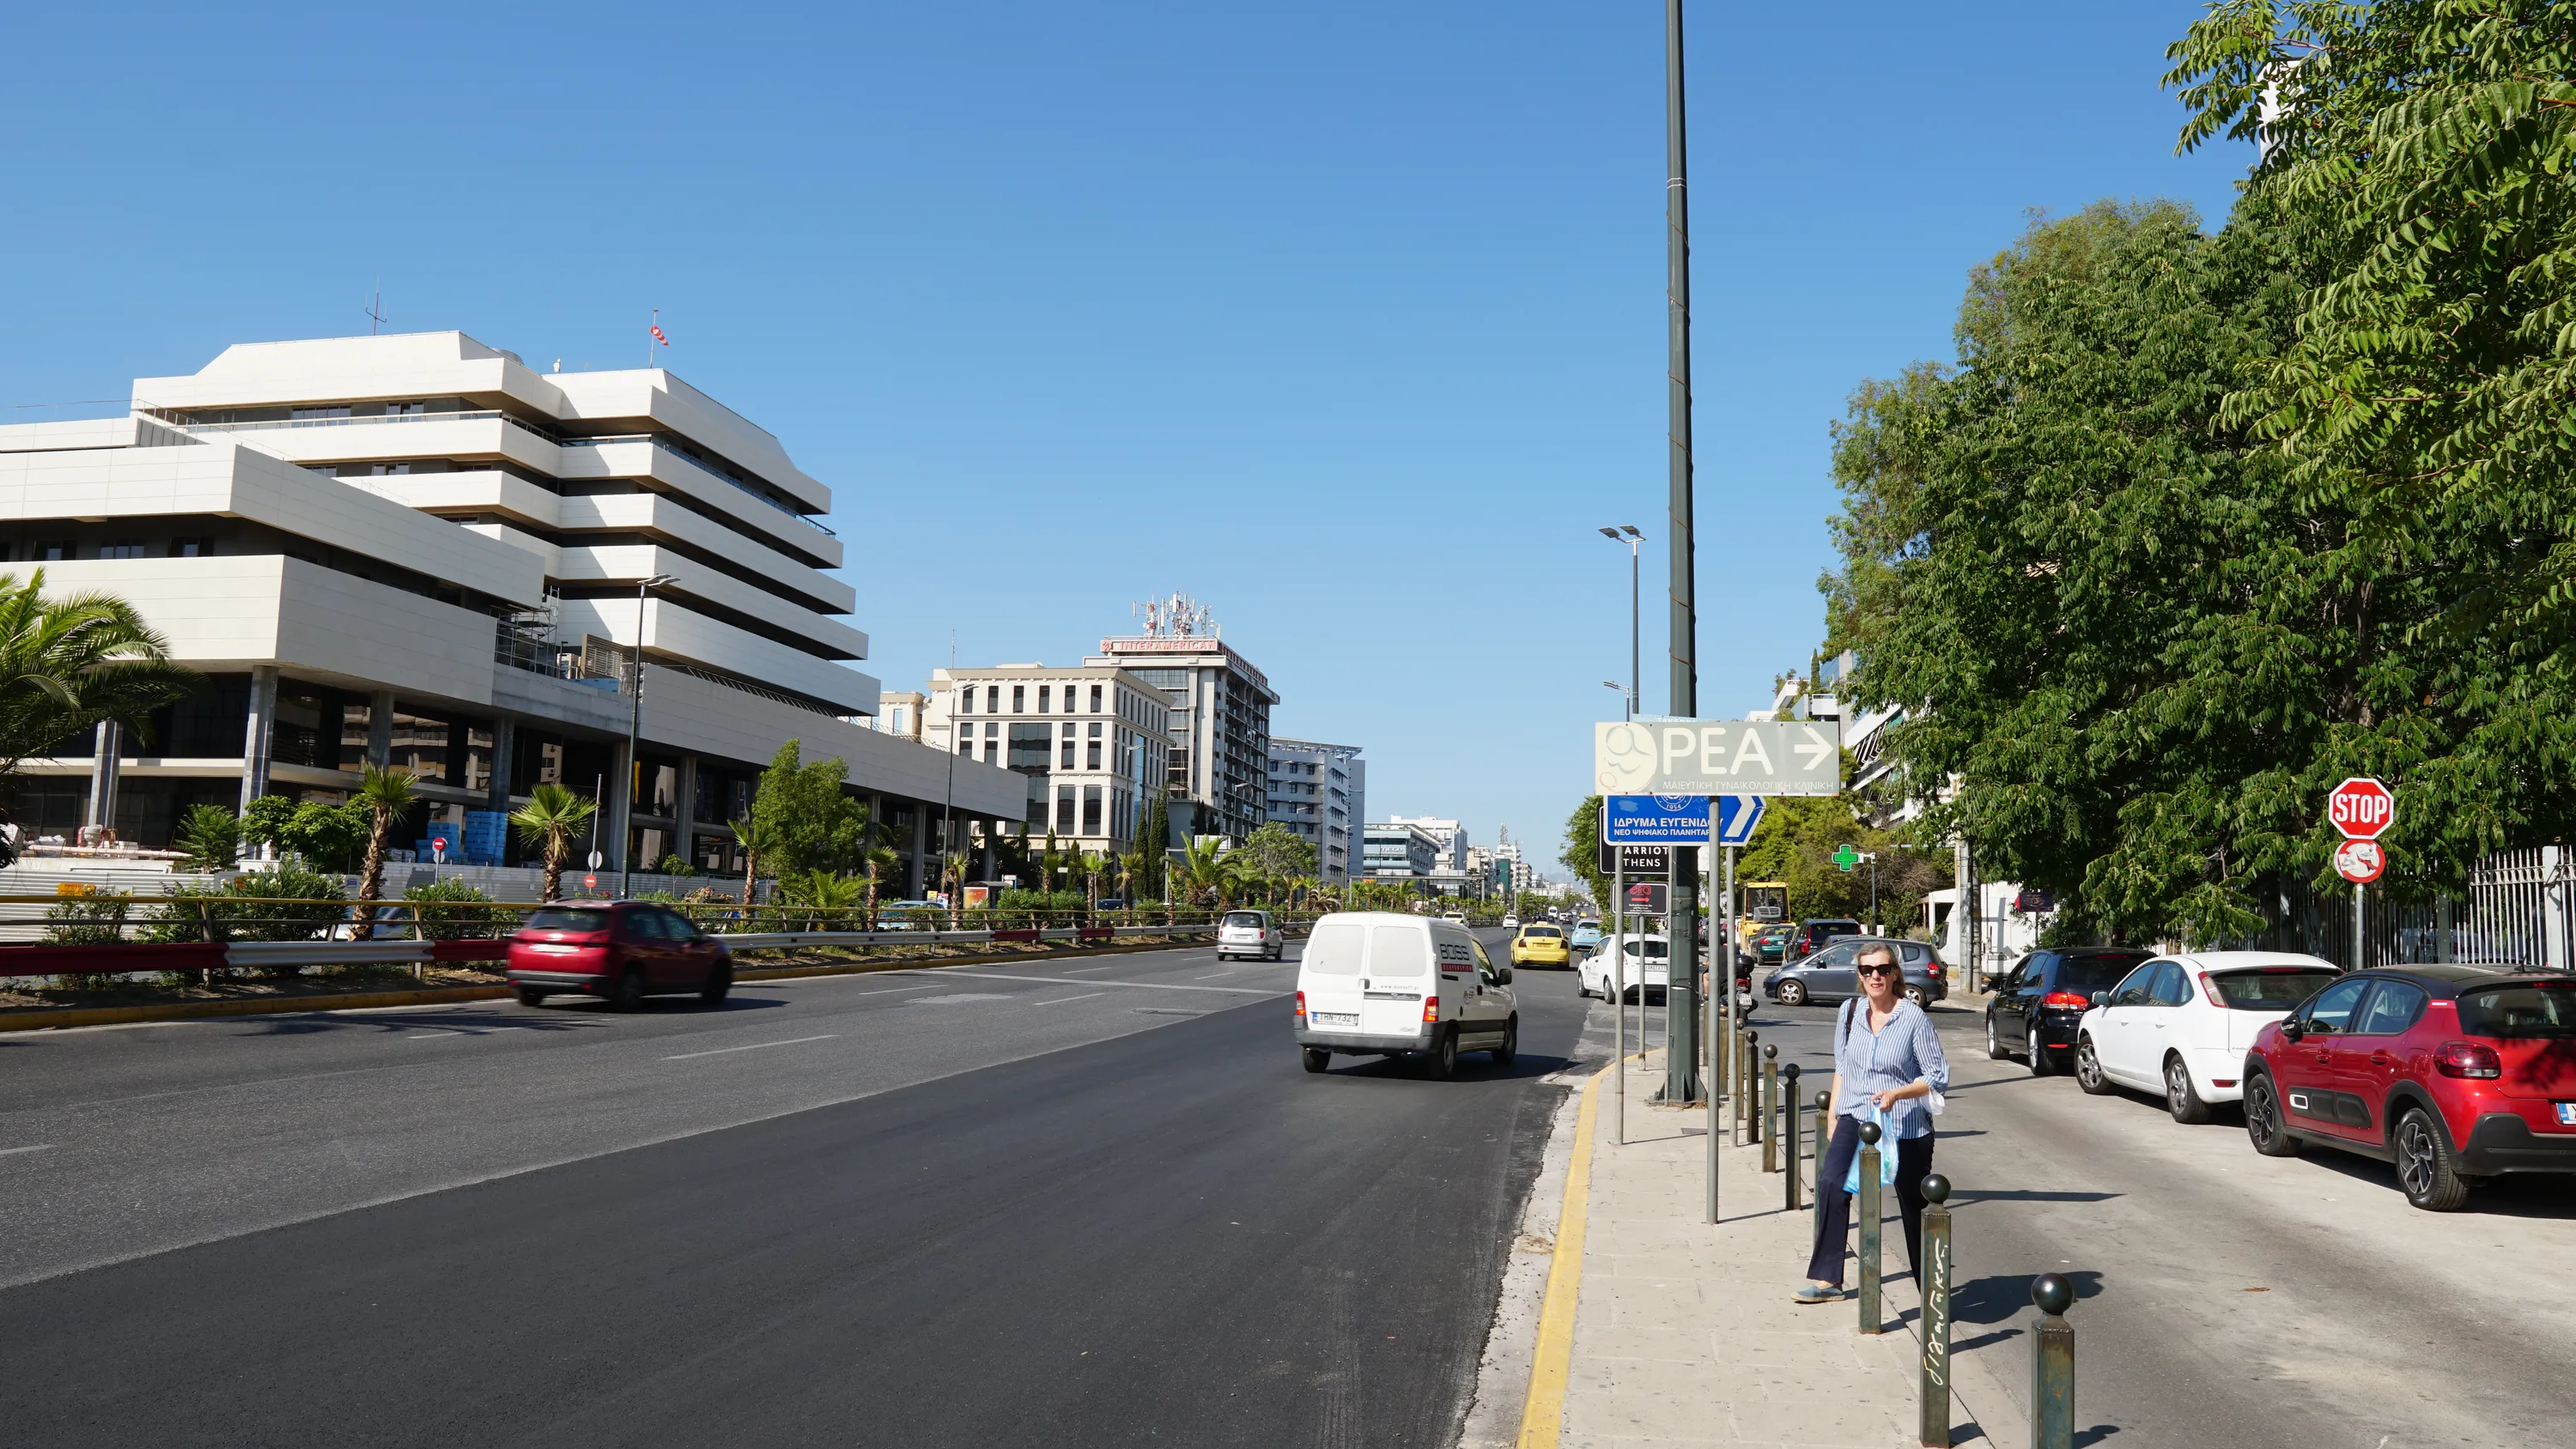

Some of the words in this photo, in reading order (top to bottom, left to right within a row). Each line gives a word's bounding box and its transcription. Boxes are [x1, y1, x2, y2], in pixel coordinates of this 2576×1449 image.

[1120, 640, 1216, 651] INTERAMERICAN
[1662, 727, 1774, 775] ΡΕΑ
[1662, 780, 1712, 791] ΜΑΙΕΥΤΙΚΗ
[1716, 780, 1791, 791] ΓΥΝΑΙΚΟΛΟΓΙΚΗ
[1795, 781, 1834, 791] ΚΛΙΝΙΚΗ
[2335, 793, 2387, 824] STOP
[1613, 817, 1658, 828] ΙΔΡΥΜΑ
[1660, 817, 1724, 828] ΕΥΓΕΝΙΔΥ
[1624, 846, 1669, 855] ARRIOT
[1623, 858, 1661, 867] THENS
[1439, 943, 1470, 961] BOSS
